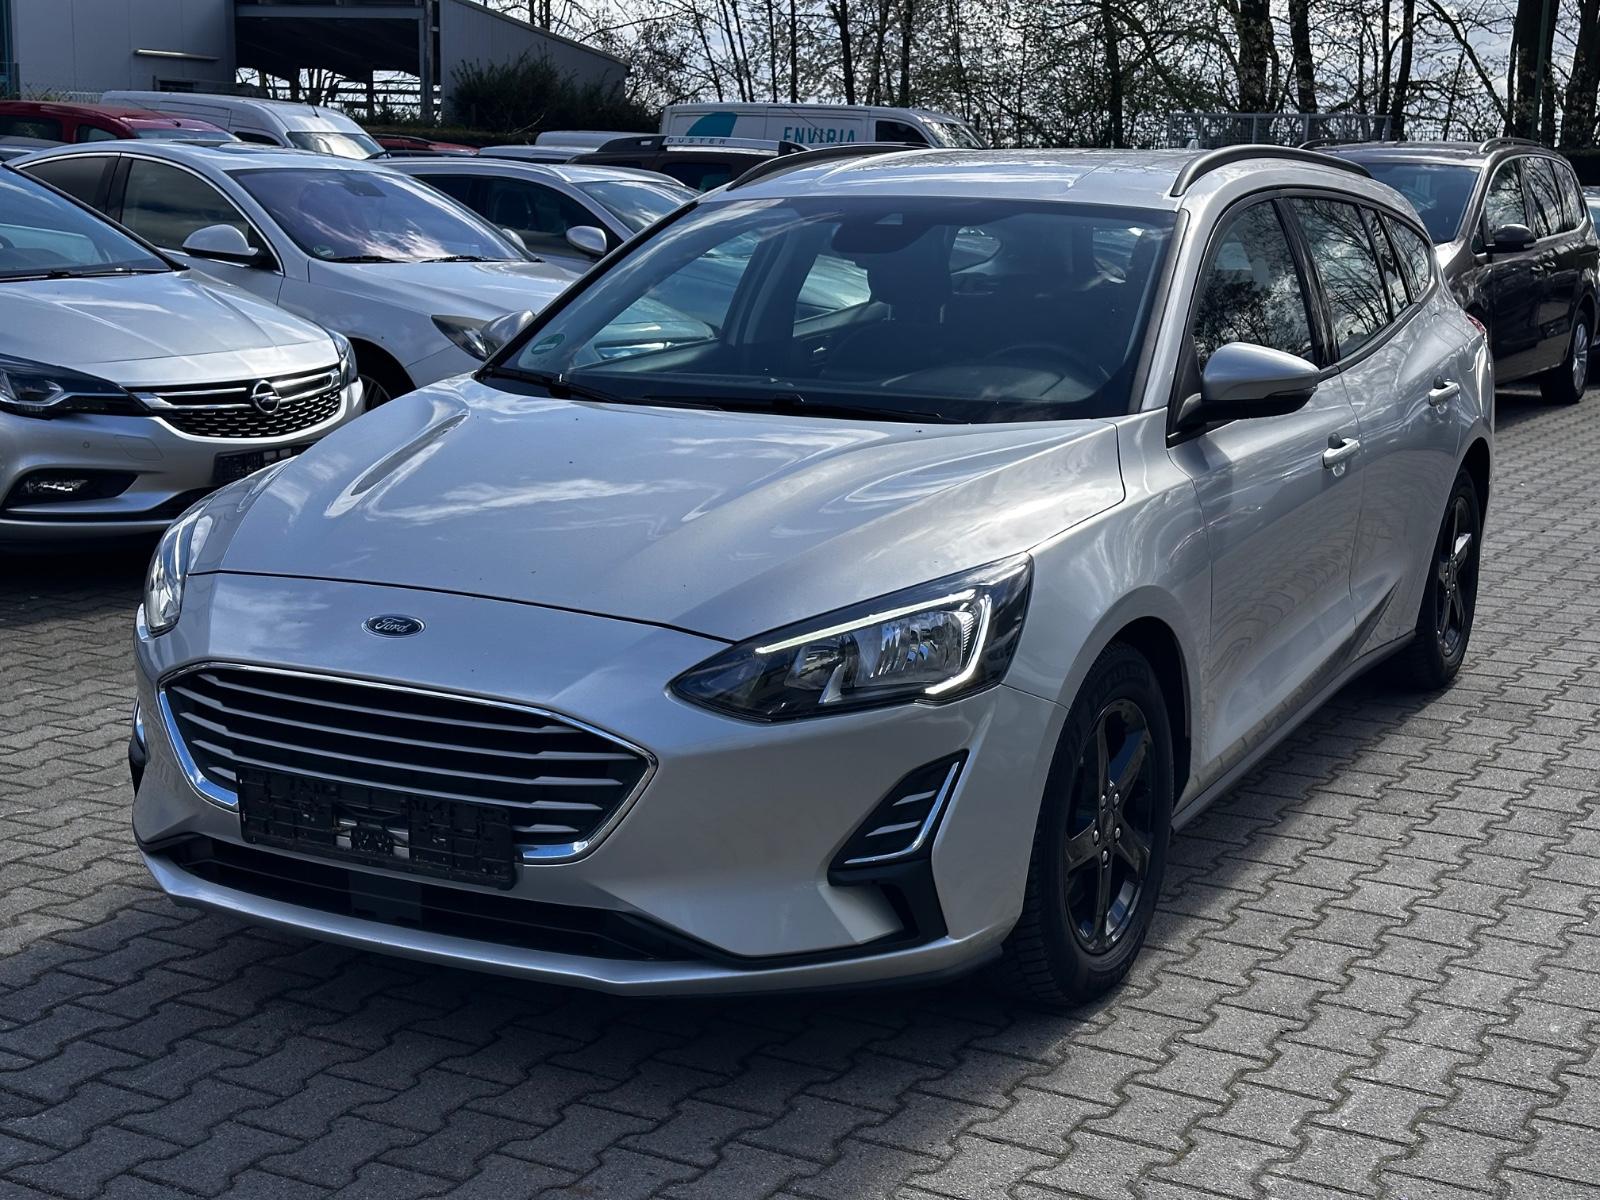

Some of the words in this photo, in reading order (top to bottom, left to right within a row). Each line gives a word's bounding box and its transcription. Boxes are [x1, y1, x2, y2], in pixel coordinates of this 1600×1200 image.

[667, 137, 727, 145] DUSTER
[783, 126, 855, 144] ENVIRIA
[375, 617, 412, 633] Ford
